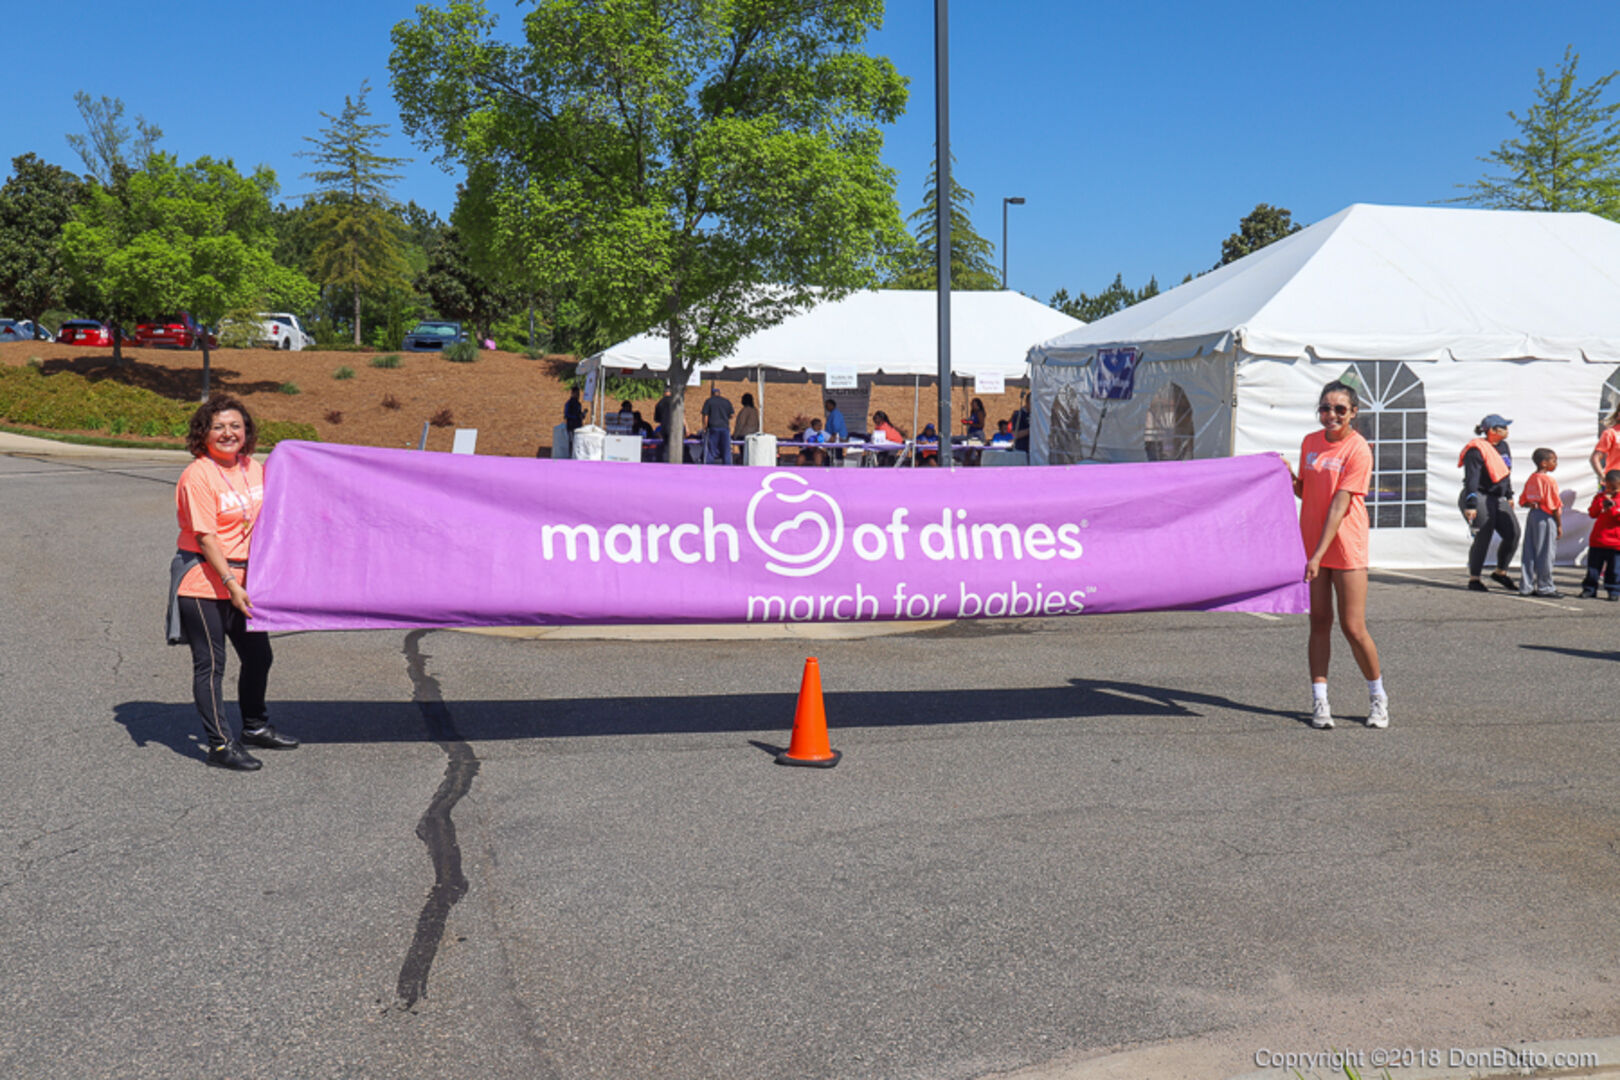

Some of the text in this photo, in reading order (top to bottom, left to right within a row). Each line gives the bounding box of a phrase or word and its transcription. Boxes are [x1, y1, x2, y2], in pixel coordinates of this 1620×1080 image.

[541, 506, 740, 564] march
[852, 507, 910, 562] of
[746, 584, 879, 622] march
[892, 583, 948, 619] for
